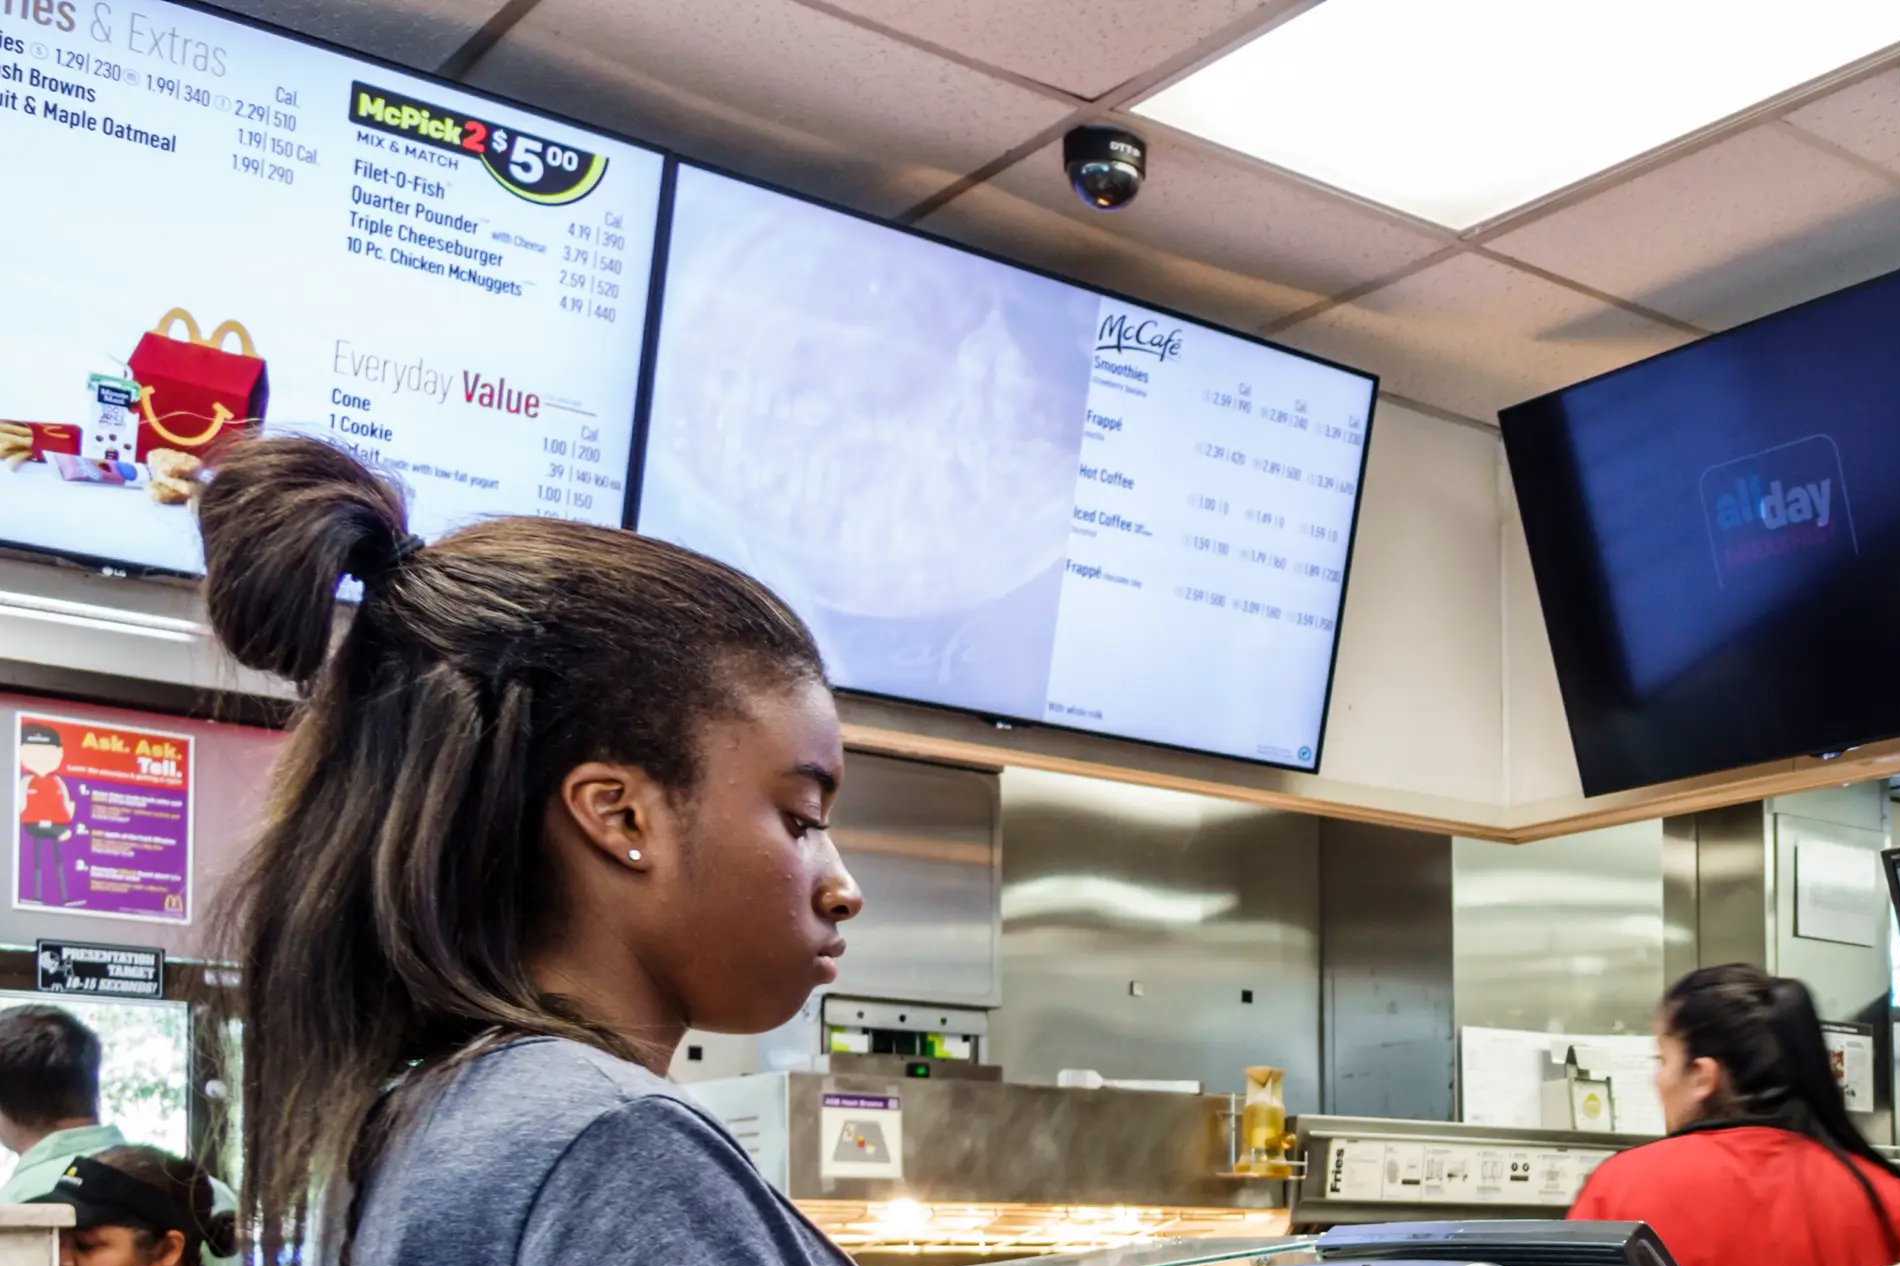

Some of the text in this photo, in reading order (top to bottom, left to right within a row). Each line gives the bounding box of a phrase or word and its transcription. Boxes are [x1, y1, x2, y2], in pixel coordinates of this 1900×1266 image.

[129, 12, 228, 78] Extras
[29, 68, 96, 103] Browns
[275, 86, 300, 108] Cal.
[23, 96, 177, 153] & Maple Oatmeal
[356, 130, 459, 171] MIX & MATCH
[351, 185, 478, 235] Quarter Pounder
[349, 210, 504, 268] Triple Cheeseburger
[347, 236, 523, 297] 10 Pc. Chicken McNuggets
[333, 339, 540, 419] Everyday Value
[1094, 356, 1149, 384] Smoothies
[331, 388, 372, 411] Cone
[340, 416, 393, 442] Cookie
[1079, 464, 1135, 491] Hot Coffee
[1073, 505, 1132, 532] Iced Coffee
[82, 732, 182, 761] Ask. Ask.
[137, 756, 182, 779] Tell.
[62, 947, 155, 966] PRESENTATION
[65, 976, 159, 994] 10-15 SECONDS!
[107, 963, 156, 979] TARGET
[1330, 1148, 1345, 1193] Fries
